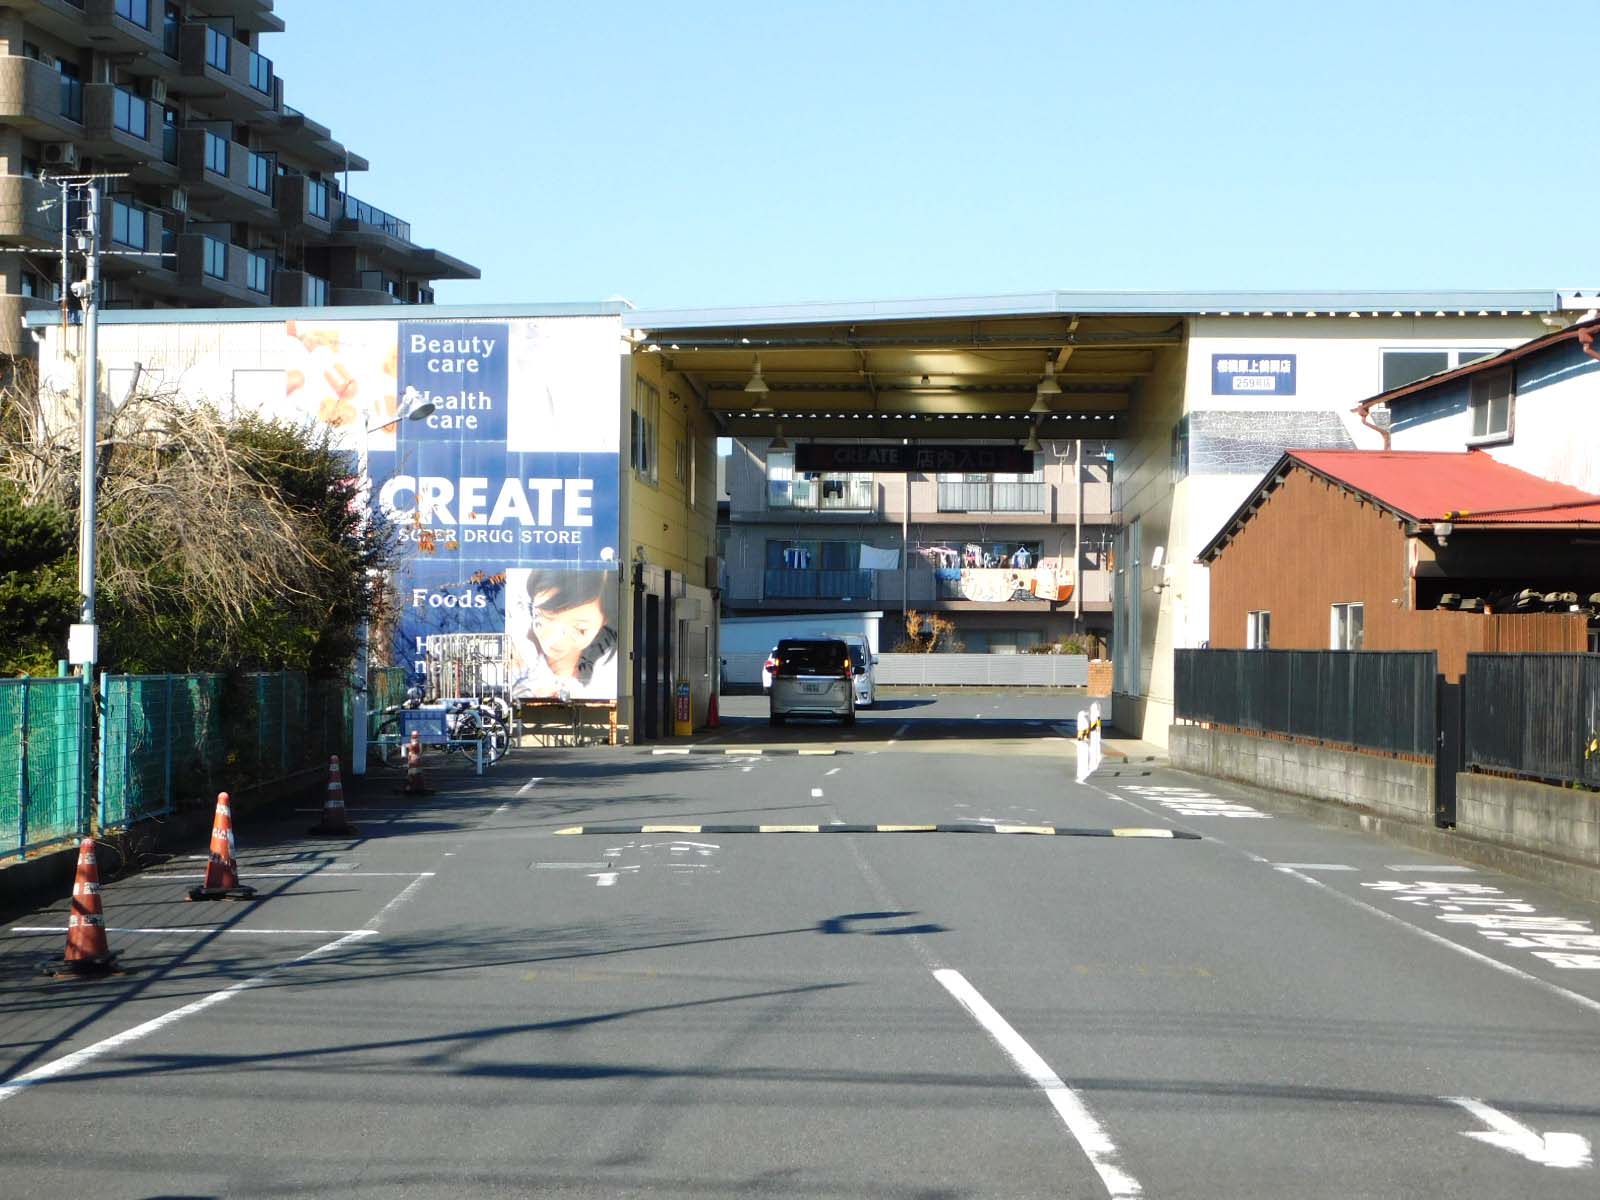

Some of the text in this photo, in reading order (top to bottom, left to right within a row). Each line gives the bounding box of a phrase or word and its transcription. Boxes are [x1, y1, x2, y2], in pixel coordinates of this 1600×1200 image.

[410, 334, 496, 357] Beauty
[427, 358, 479, 373] care
[426, 415, 478, 429] care
[832, 449, 996, 467] CREATE 店内入口
[379, 475, 594, 527] CREATE
[463, 529, 514, 543] DRUG
[520, 530, 582, 544] STORE
[412, 588, 487, 608] Foods
